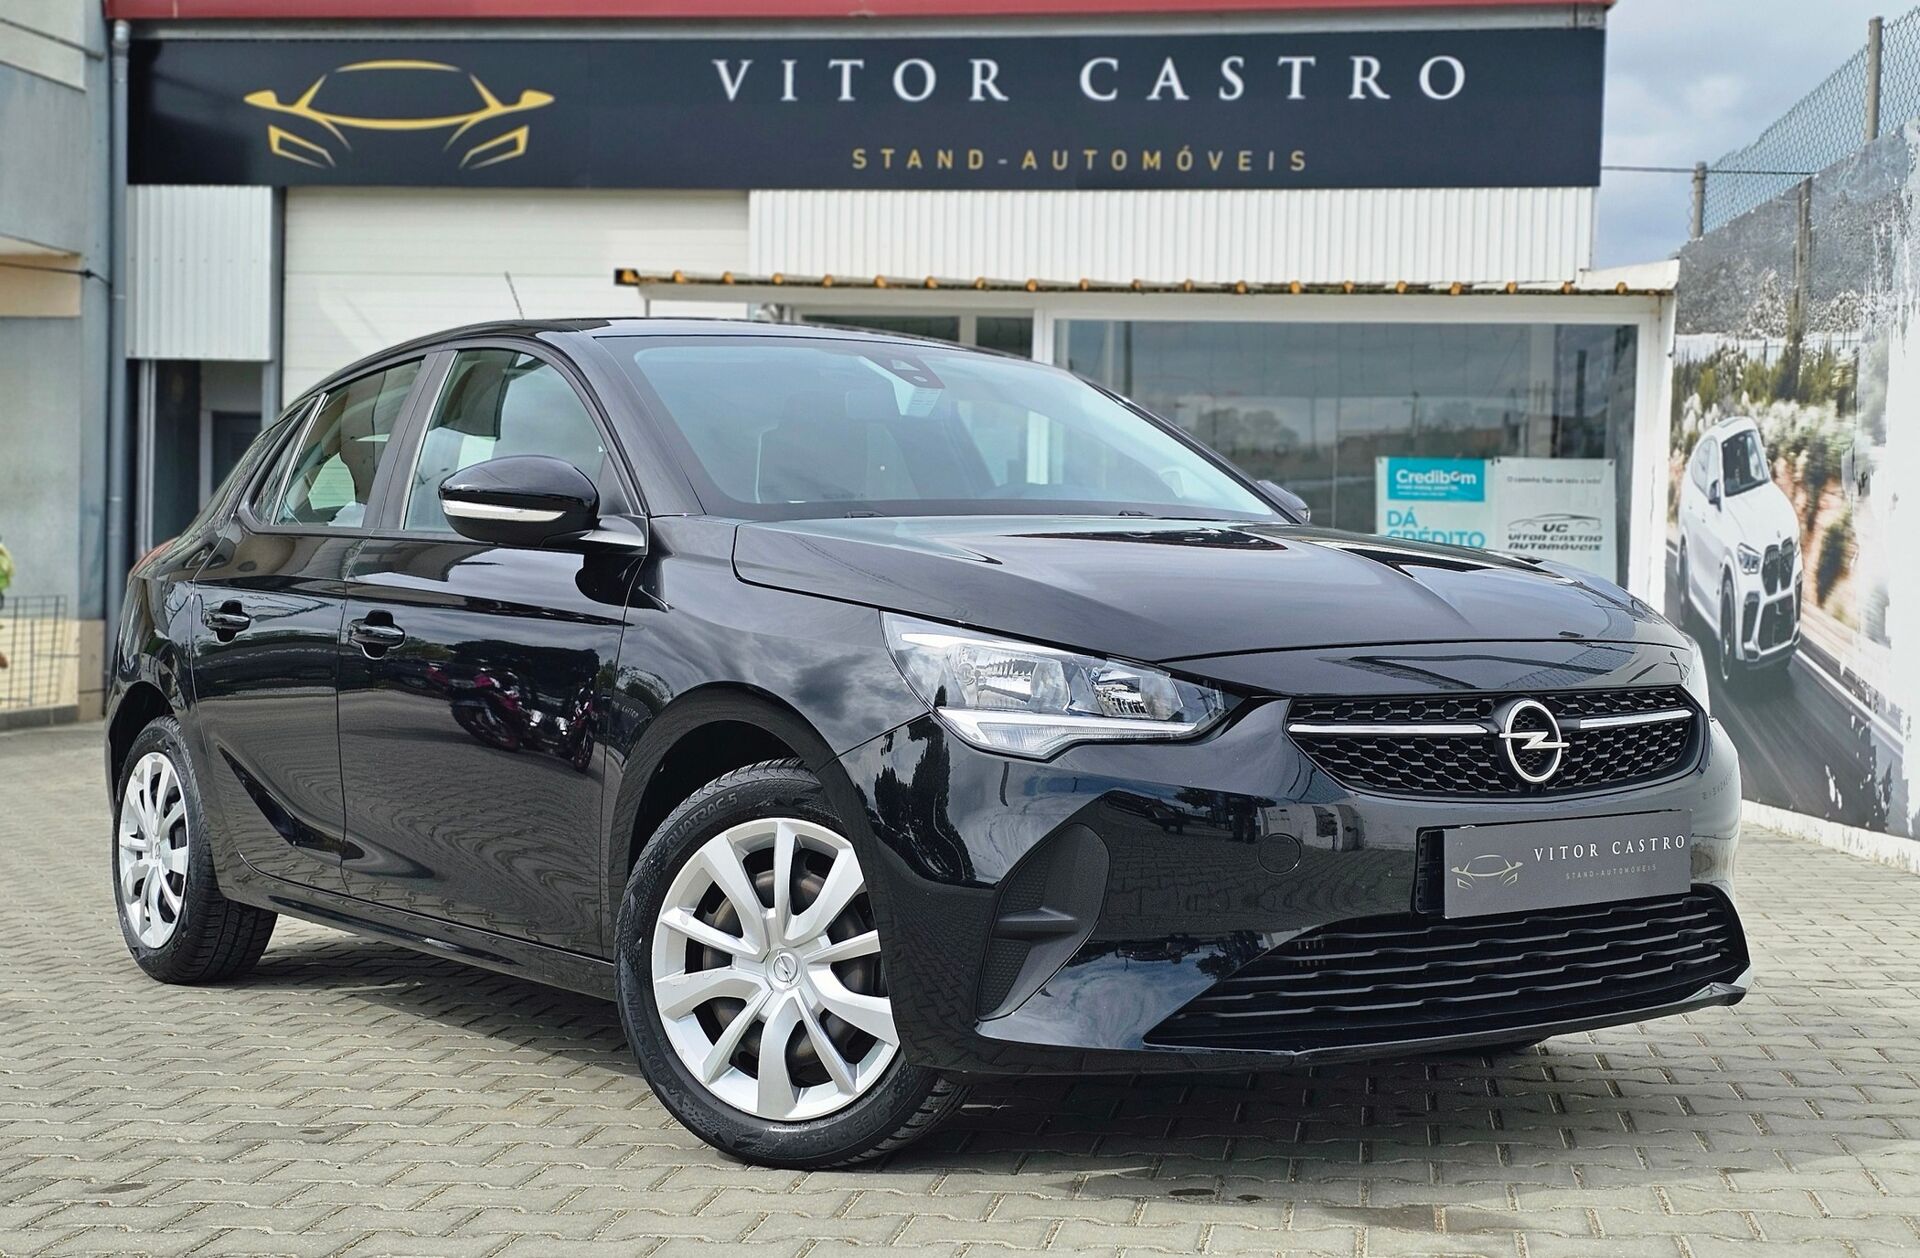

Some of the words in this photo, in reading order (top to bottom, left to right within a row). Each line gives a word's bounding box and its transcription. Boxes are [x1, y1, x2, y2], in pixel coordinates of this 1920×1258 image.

[713, 59, 1008, 101] VITOR
[1080, 56, 1465, 101] CASTRO
[854, 147, 1304, 170] STAND-AUTOMÓVEIS
[1396, 469, 1477, 485] Credibom
[1387, 506, 1418, 528] DÁ
[728, 792, 738, 804] 5
[1534, 844, 1598, 861] VITOR
[1612, 836, 1684, 854] CASTRO
